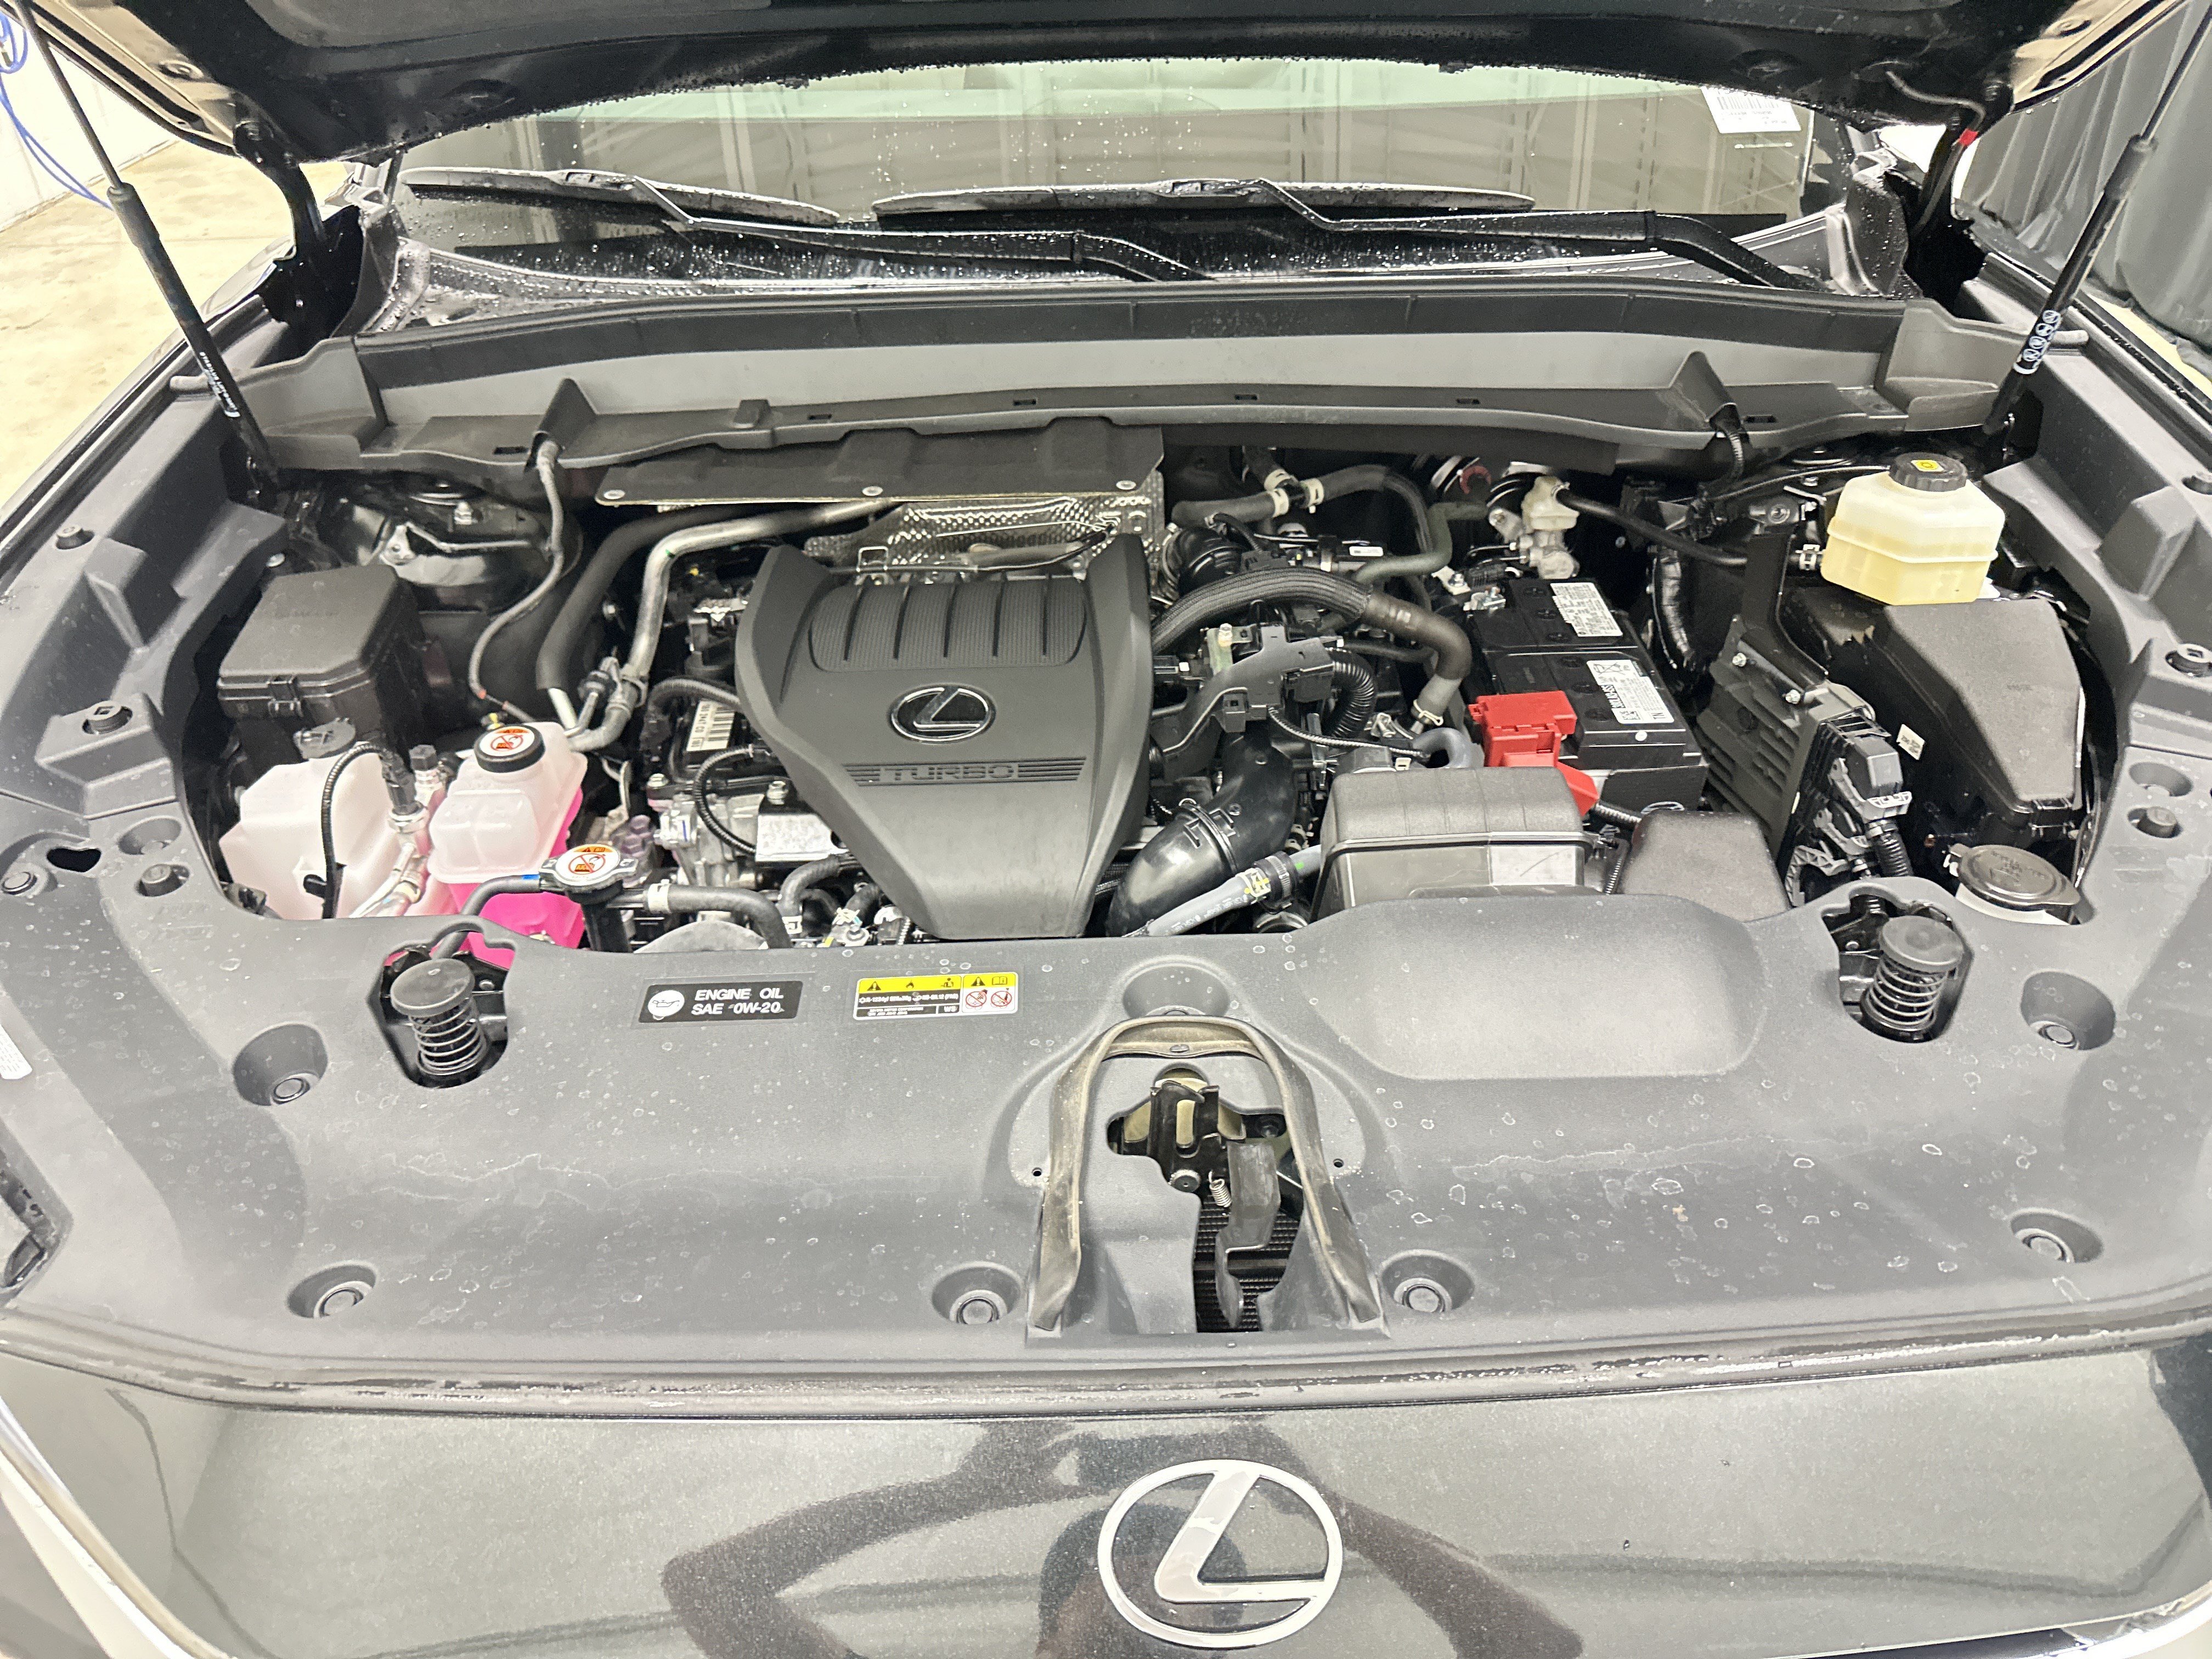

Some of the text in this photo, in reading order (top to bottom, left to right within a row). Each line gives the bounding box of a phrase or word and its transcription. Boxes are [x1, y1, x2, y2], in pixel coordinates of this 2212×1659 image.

[884, 764, 1014, 780] TURBO
[695, 988, 784, 1001] ENGINE OIL
[691, 1001, 781, 1015] SAE 0W-20
